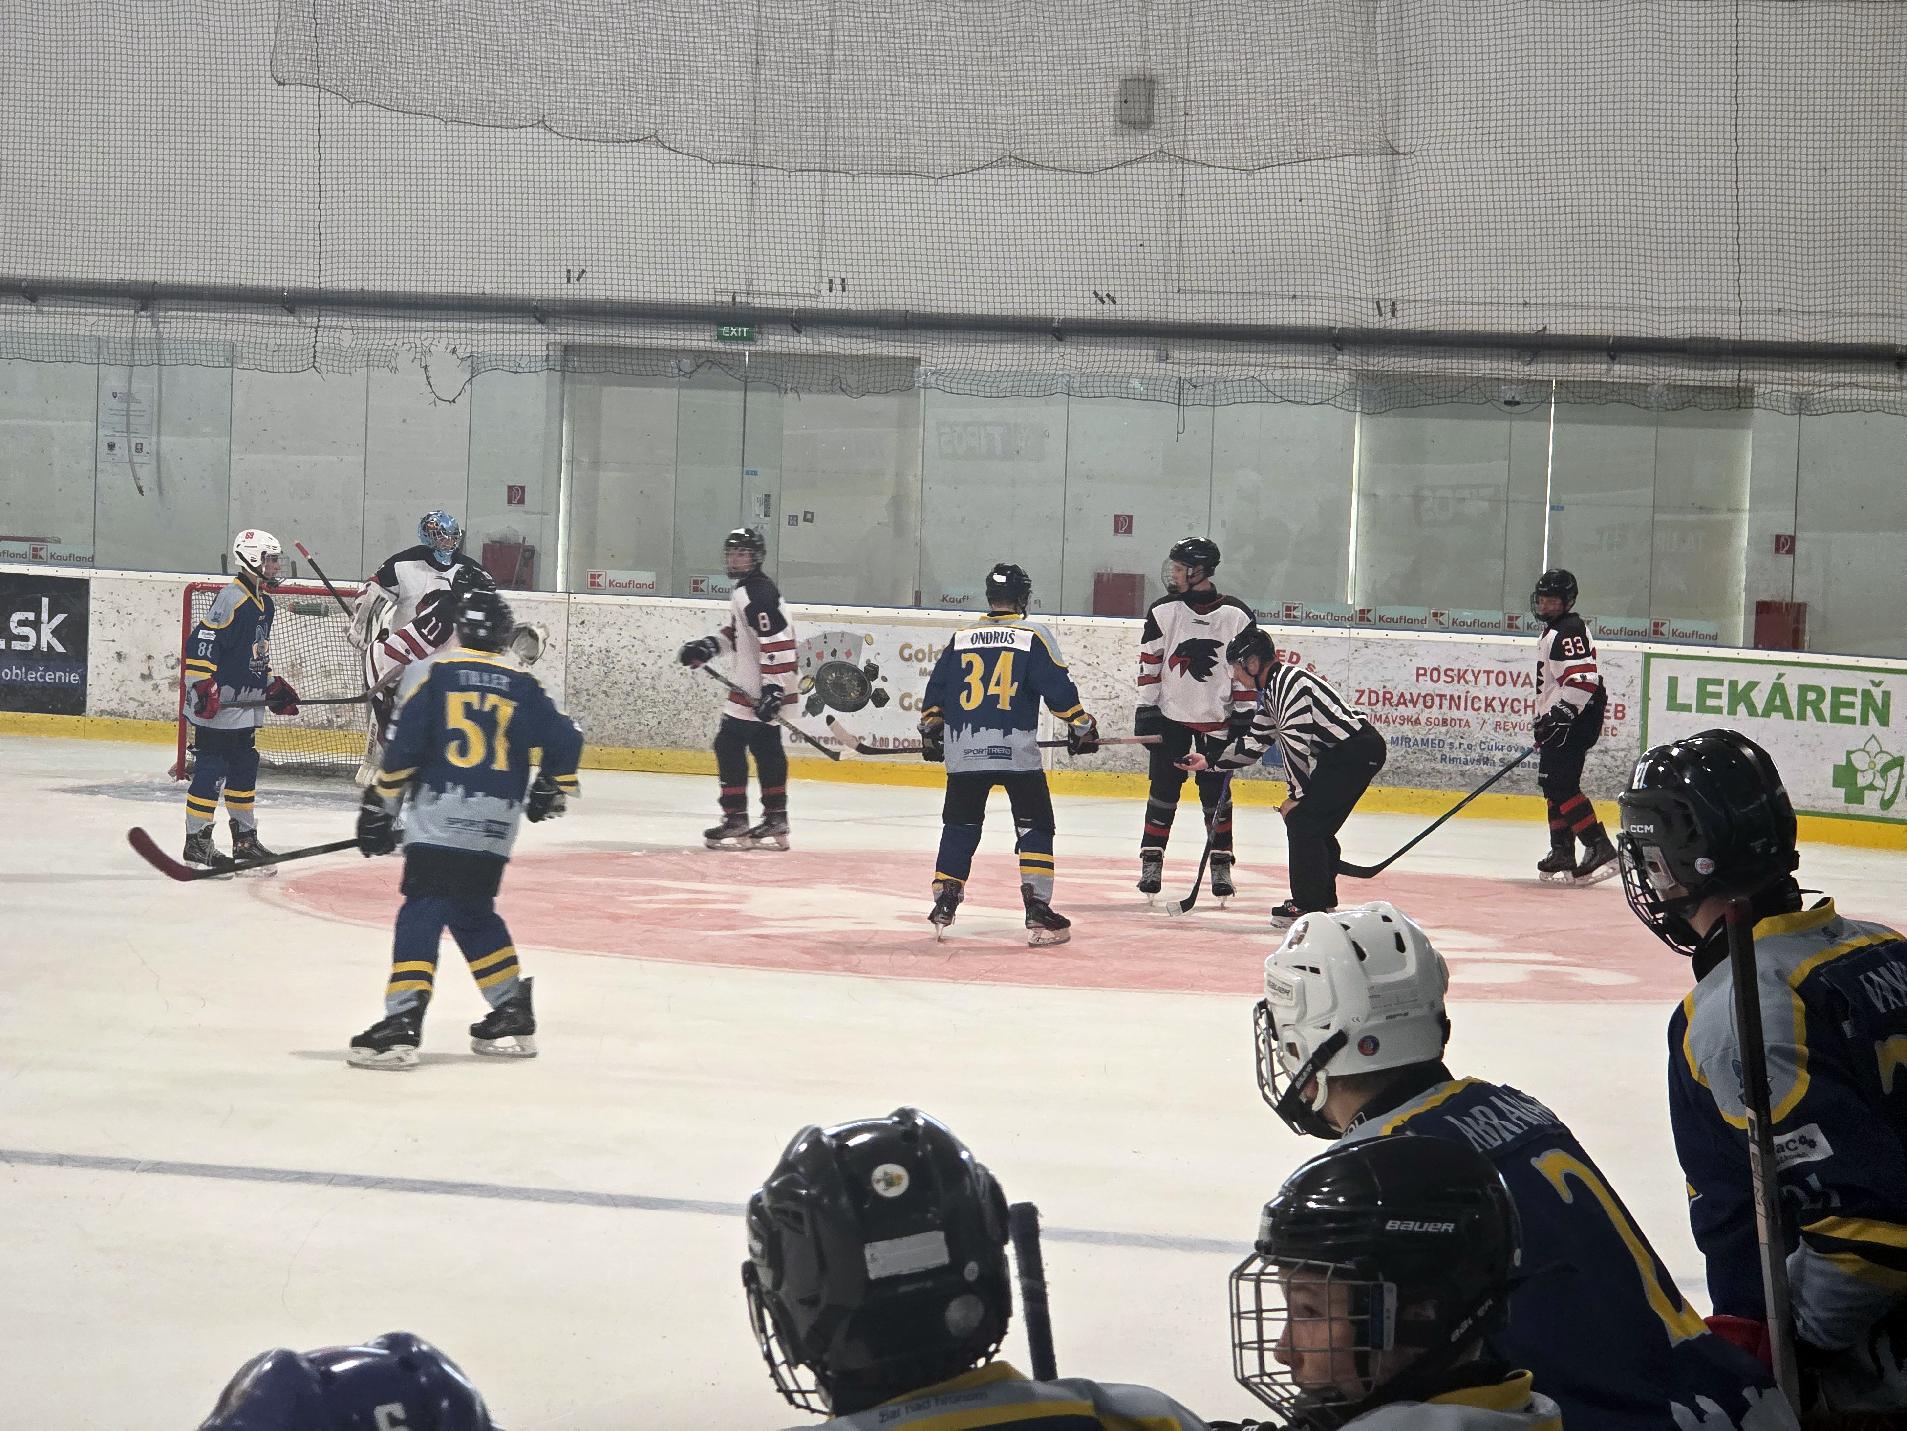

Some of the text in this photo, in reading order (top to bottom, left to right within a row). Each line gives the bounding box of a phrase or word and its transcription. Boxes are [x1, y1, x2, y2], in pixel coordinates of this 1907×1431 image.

[722, 326, 750, 337] EXIT
[50, 552, 95, 563] Kaufland
[608, 578, 655, 590] Kaufland
[1253, 608, 1280, 619] fland
[1304, 611, 1354, 622] Kaufland
[1378, 614, 1428, 626] Kaufland
[758, 612, 771, 632] 8
[1451, 618, 1501, 630] Kaufland
[970, 629, 1016, 646] ONDRUŠ
[1598, 625, 1648, 638] Kaufland
[1671, 628, 1719, 642] Kaufland
[1561, 636, 1586, 656] 33
[1, 664, 81, 685] oblečenie
[959, 651, 1018, 711] 34
[1415, 666, 1535, 689] POSKYTOVA
[1665, 672, 1892, 728] LEKÁREŇ
[1366, 713, 1422, 726] IMAVSKÁ
[445, 690, 517, 772] 57
[1630, 824, 1654, 834] CCM
[1384, 1218, 1456, 1234] BAUER
